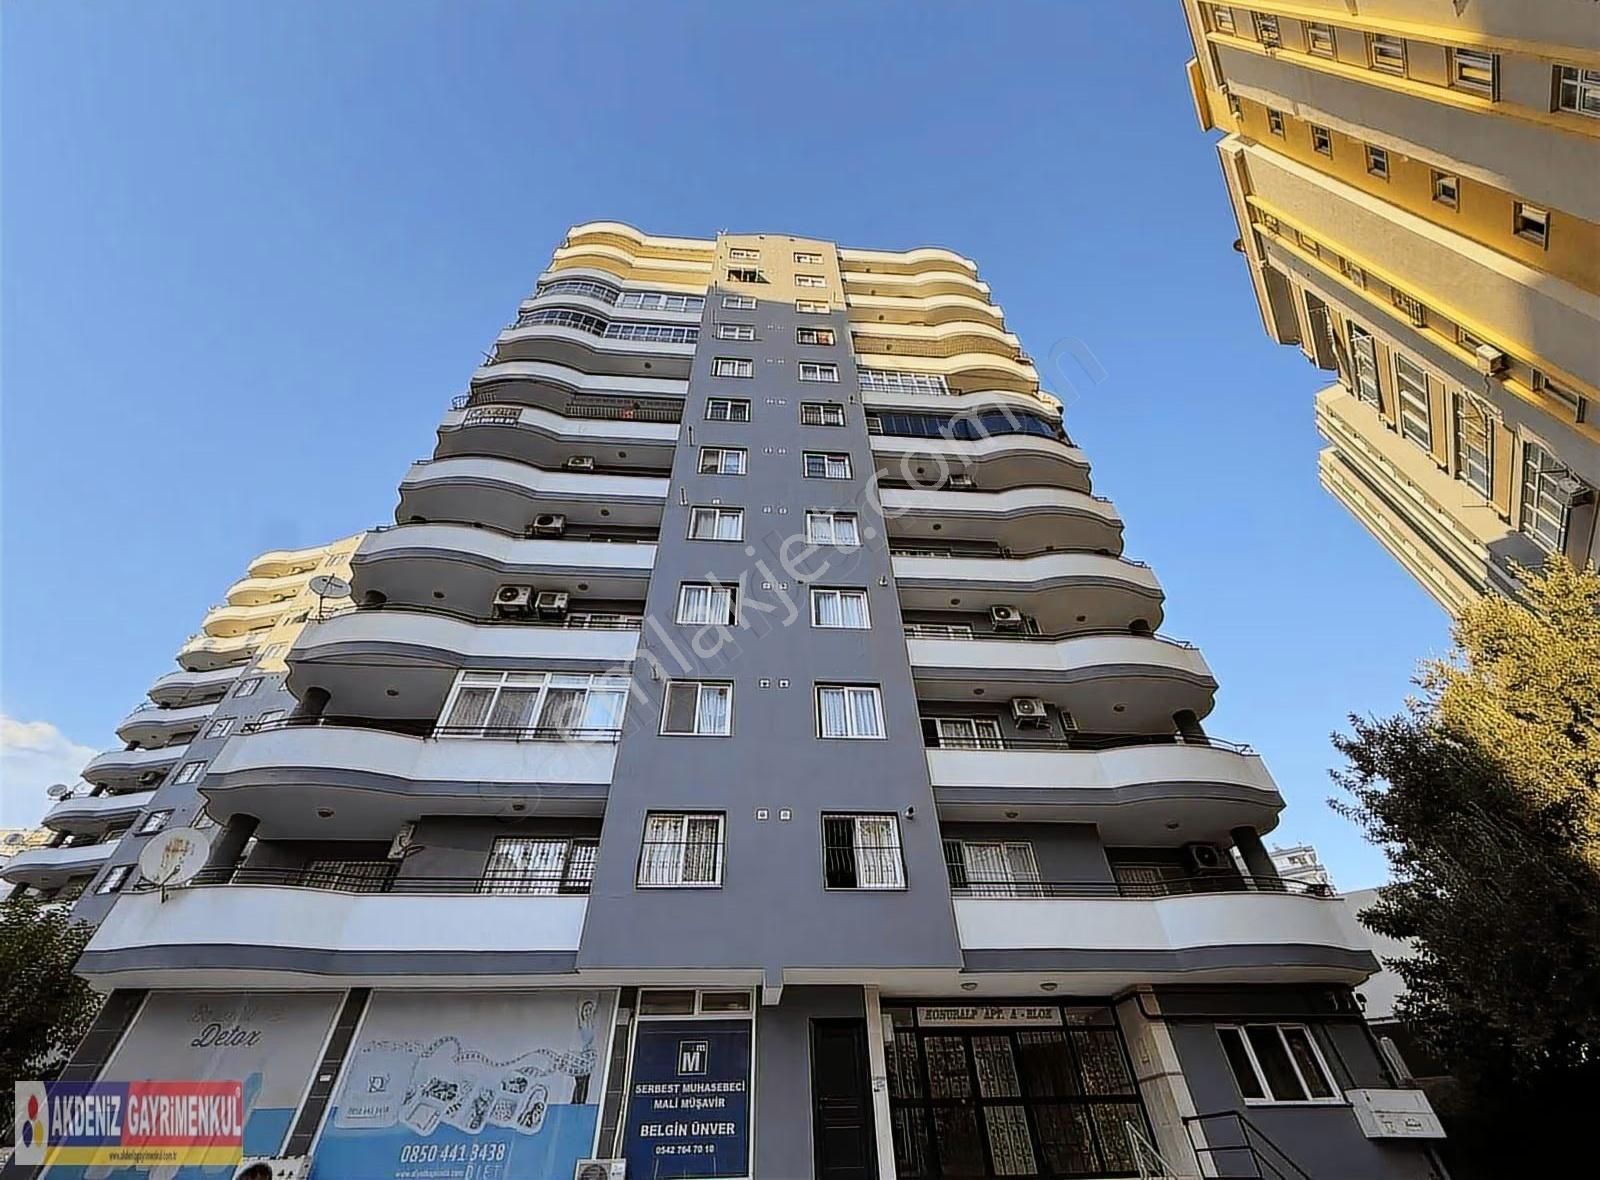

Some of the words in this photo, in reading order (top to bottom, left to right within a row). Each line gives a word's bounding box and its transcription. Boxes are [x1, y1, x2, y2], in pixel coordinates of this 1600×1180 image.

[191, 1023, 261, 1047] Detox
[635, 1084, 680, 1094] SERBEST
[682, 1080, 745, 1093] MUHASEBECİ
[653, 1097, 678, 1109] MALİ
[680, 1096, 725, 1110] MÜŞAVİR
[640, 1121, 687, 1137] BELGİN
[691, 1121, 735, 1135] ÜNVER
[401, 1144, 438, 1163] 0850
[440, 1144, 466, 1162] 441
[655, 1145, 676, 1155] 0542
[677, 1145, 691, 1155] 764
[693, 1145, 703, 1154] 70
